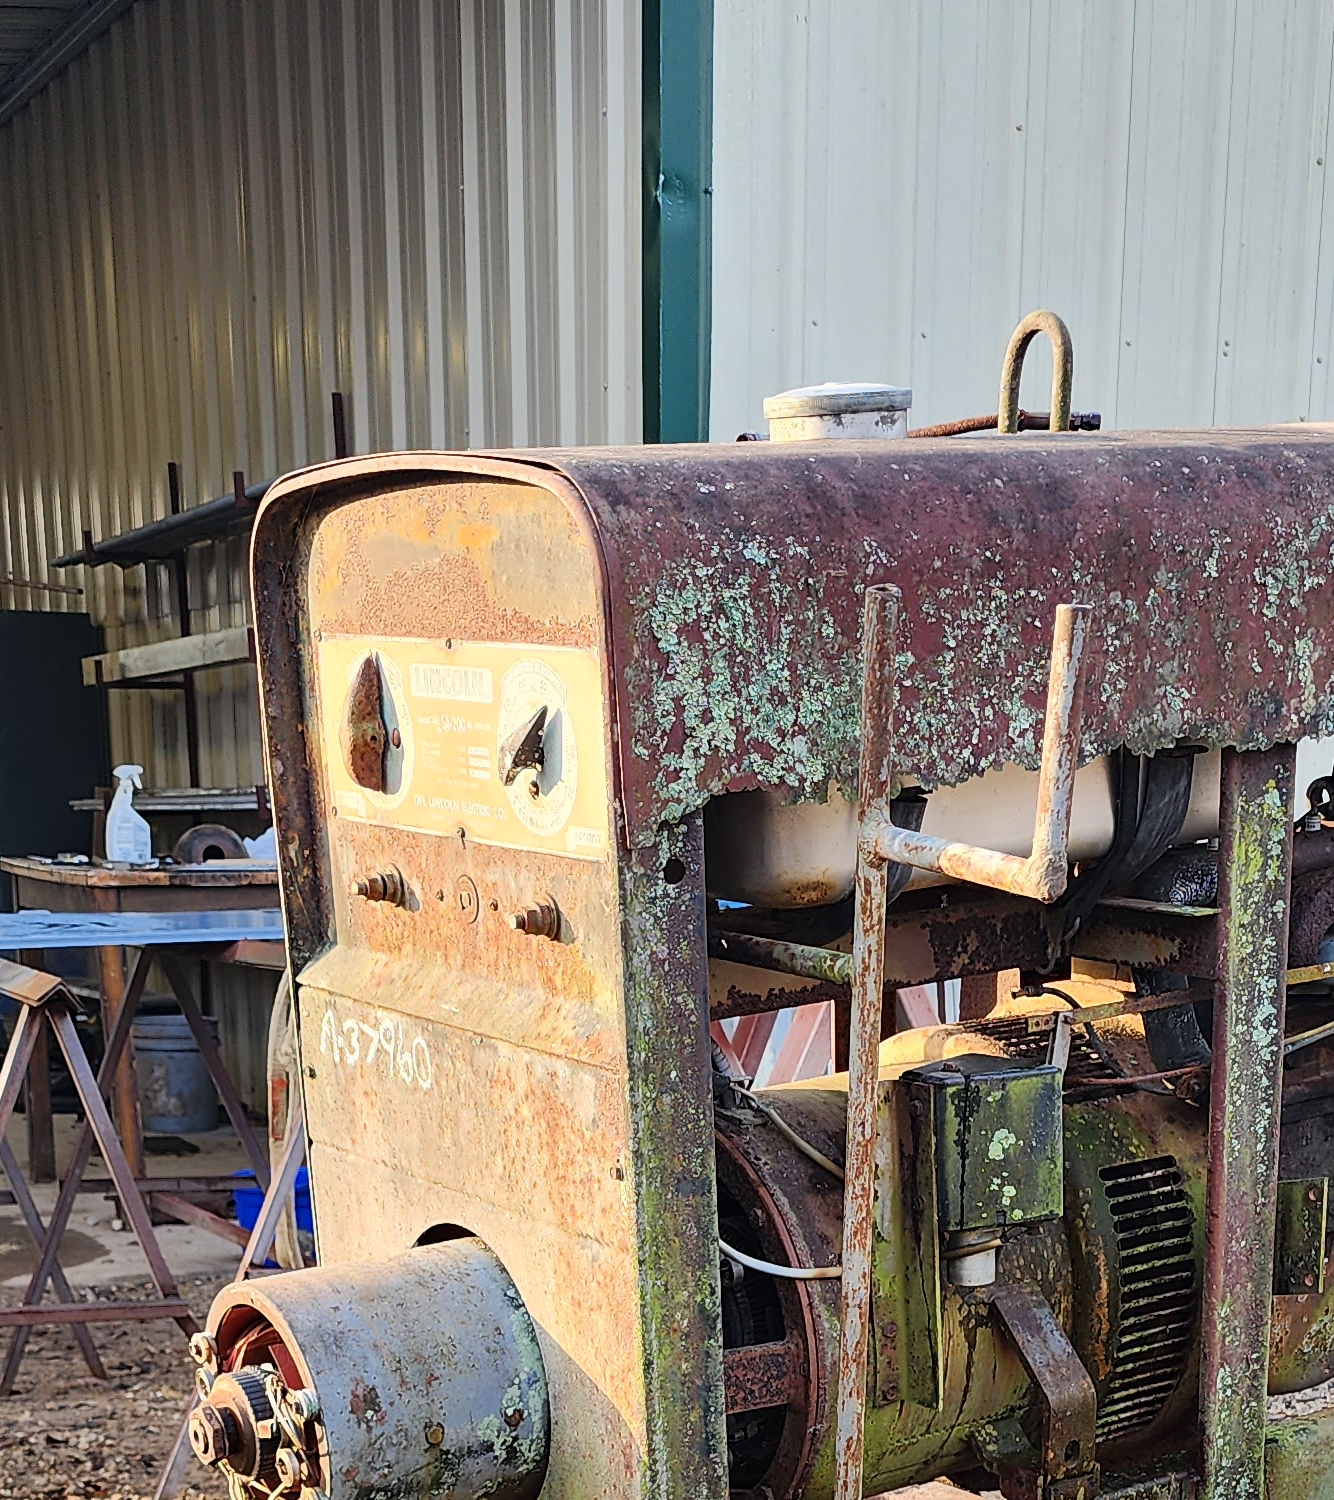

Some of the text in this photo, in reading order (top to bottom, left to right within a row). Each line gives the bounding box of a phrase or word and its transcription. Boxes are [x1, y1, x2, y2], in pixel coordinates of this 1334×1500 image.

[414, 666, 484, 697] LINCOLN
[413, 793, 426, 806] THE
[428, 796, 460, 811] LINCOLN
